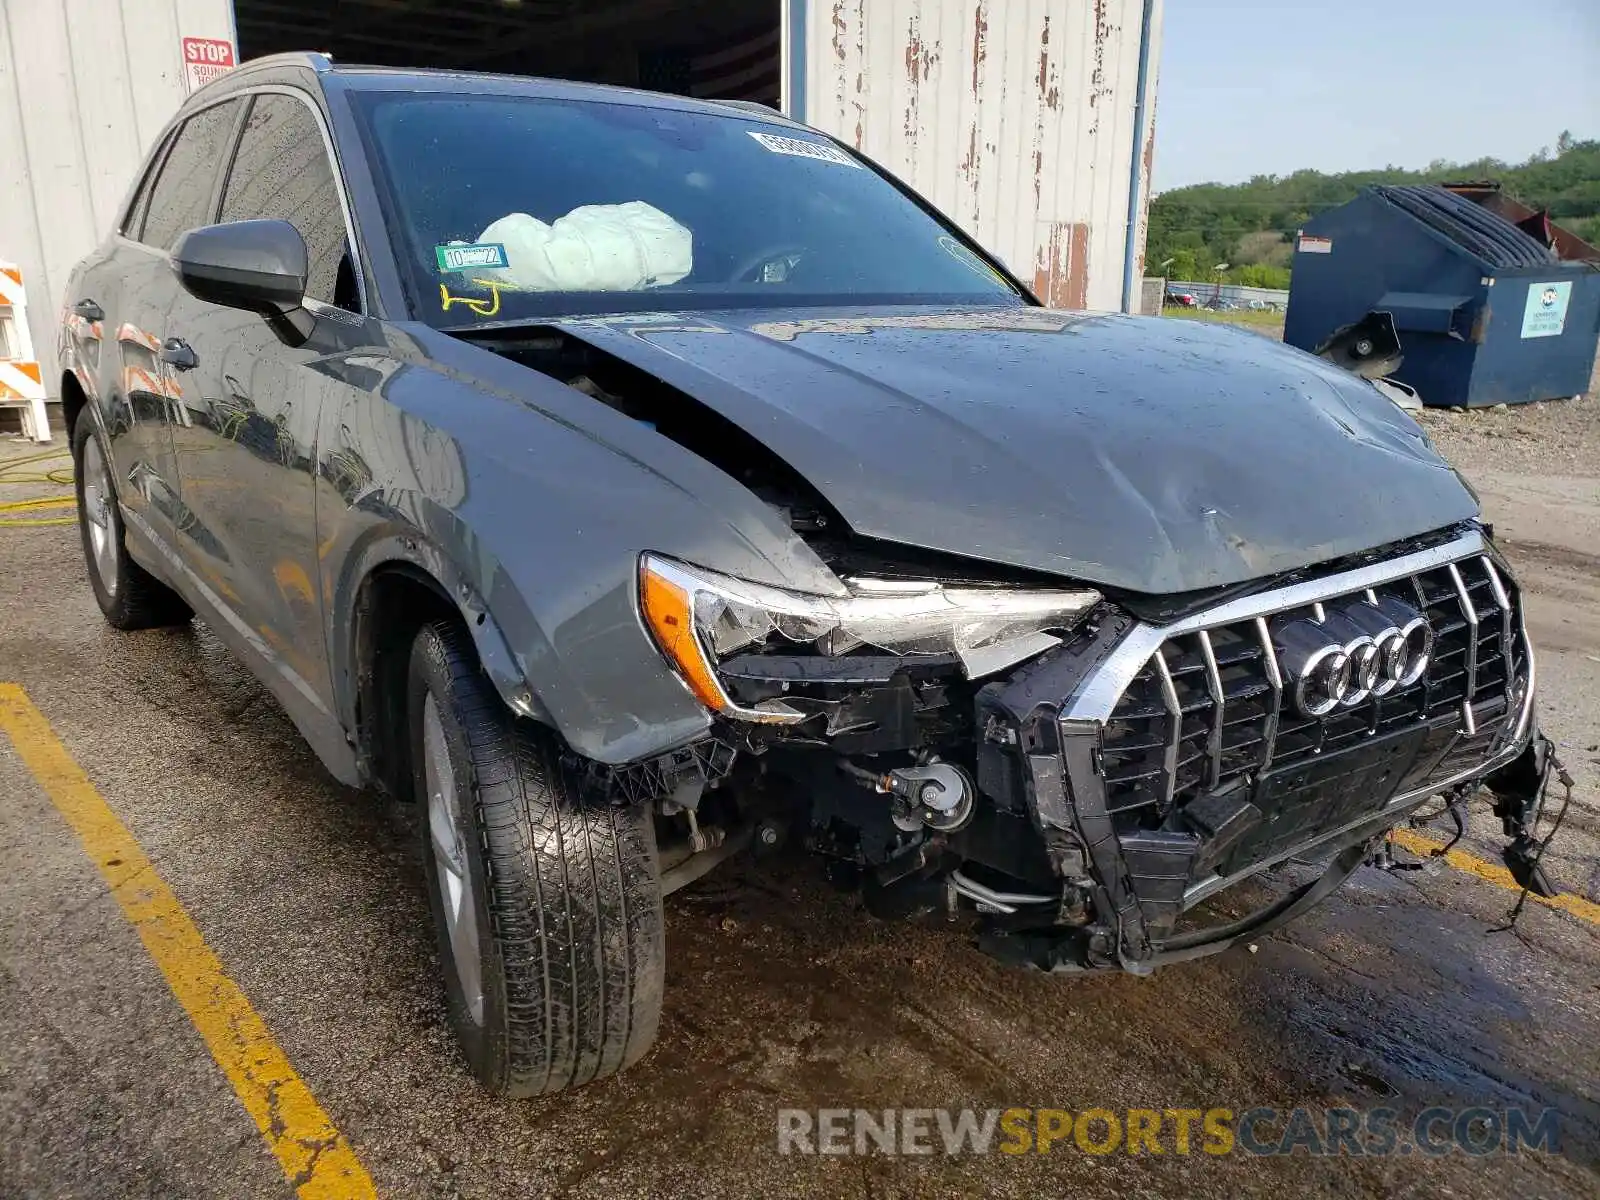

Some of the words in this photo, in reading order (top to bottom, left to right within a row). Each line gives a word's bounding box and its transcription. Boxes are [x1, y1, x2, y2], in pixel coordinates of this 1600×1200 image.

[186, 42, 229, 62] STOP
[447, 250, 463, 267] 10
[484, 247, 501, 264] 22
